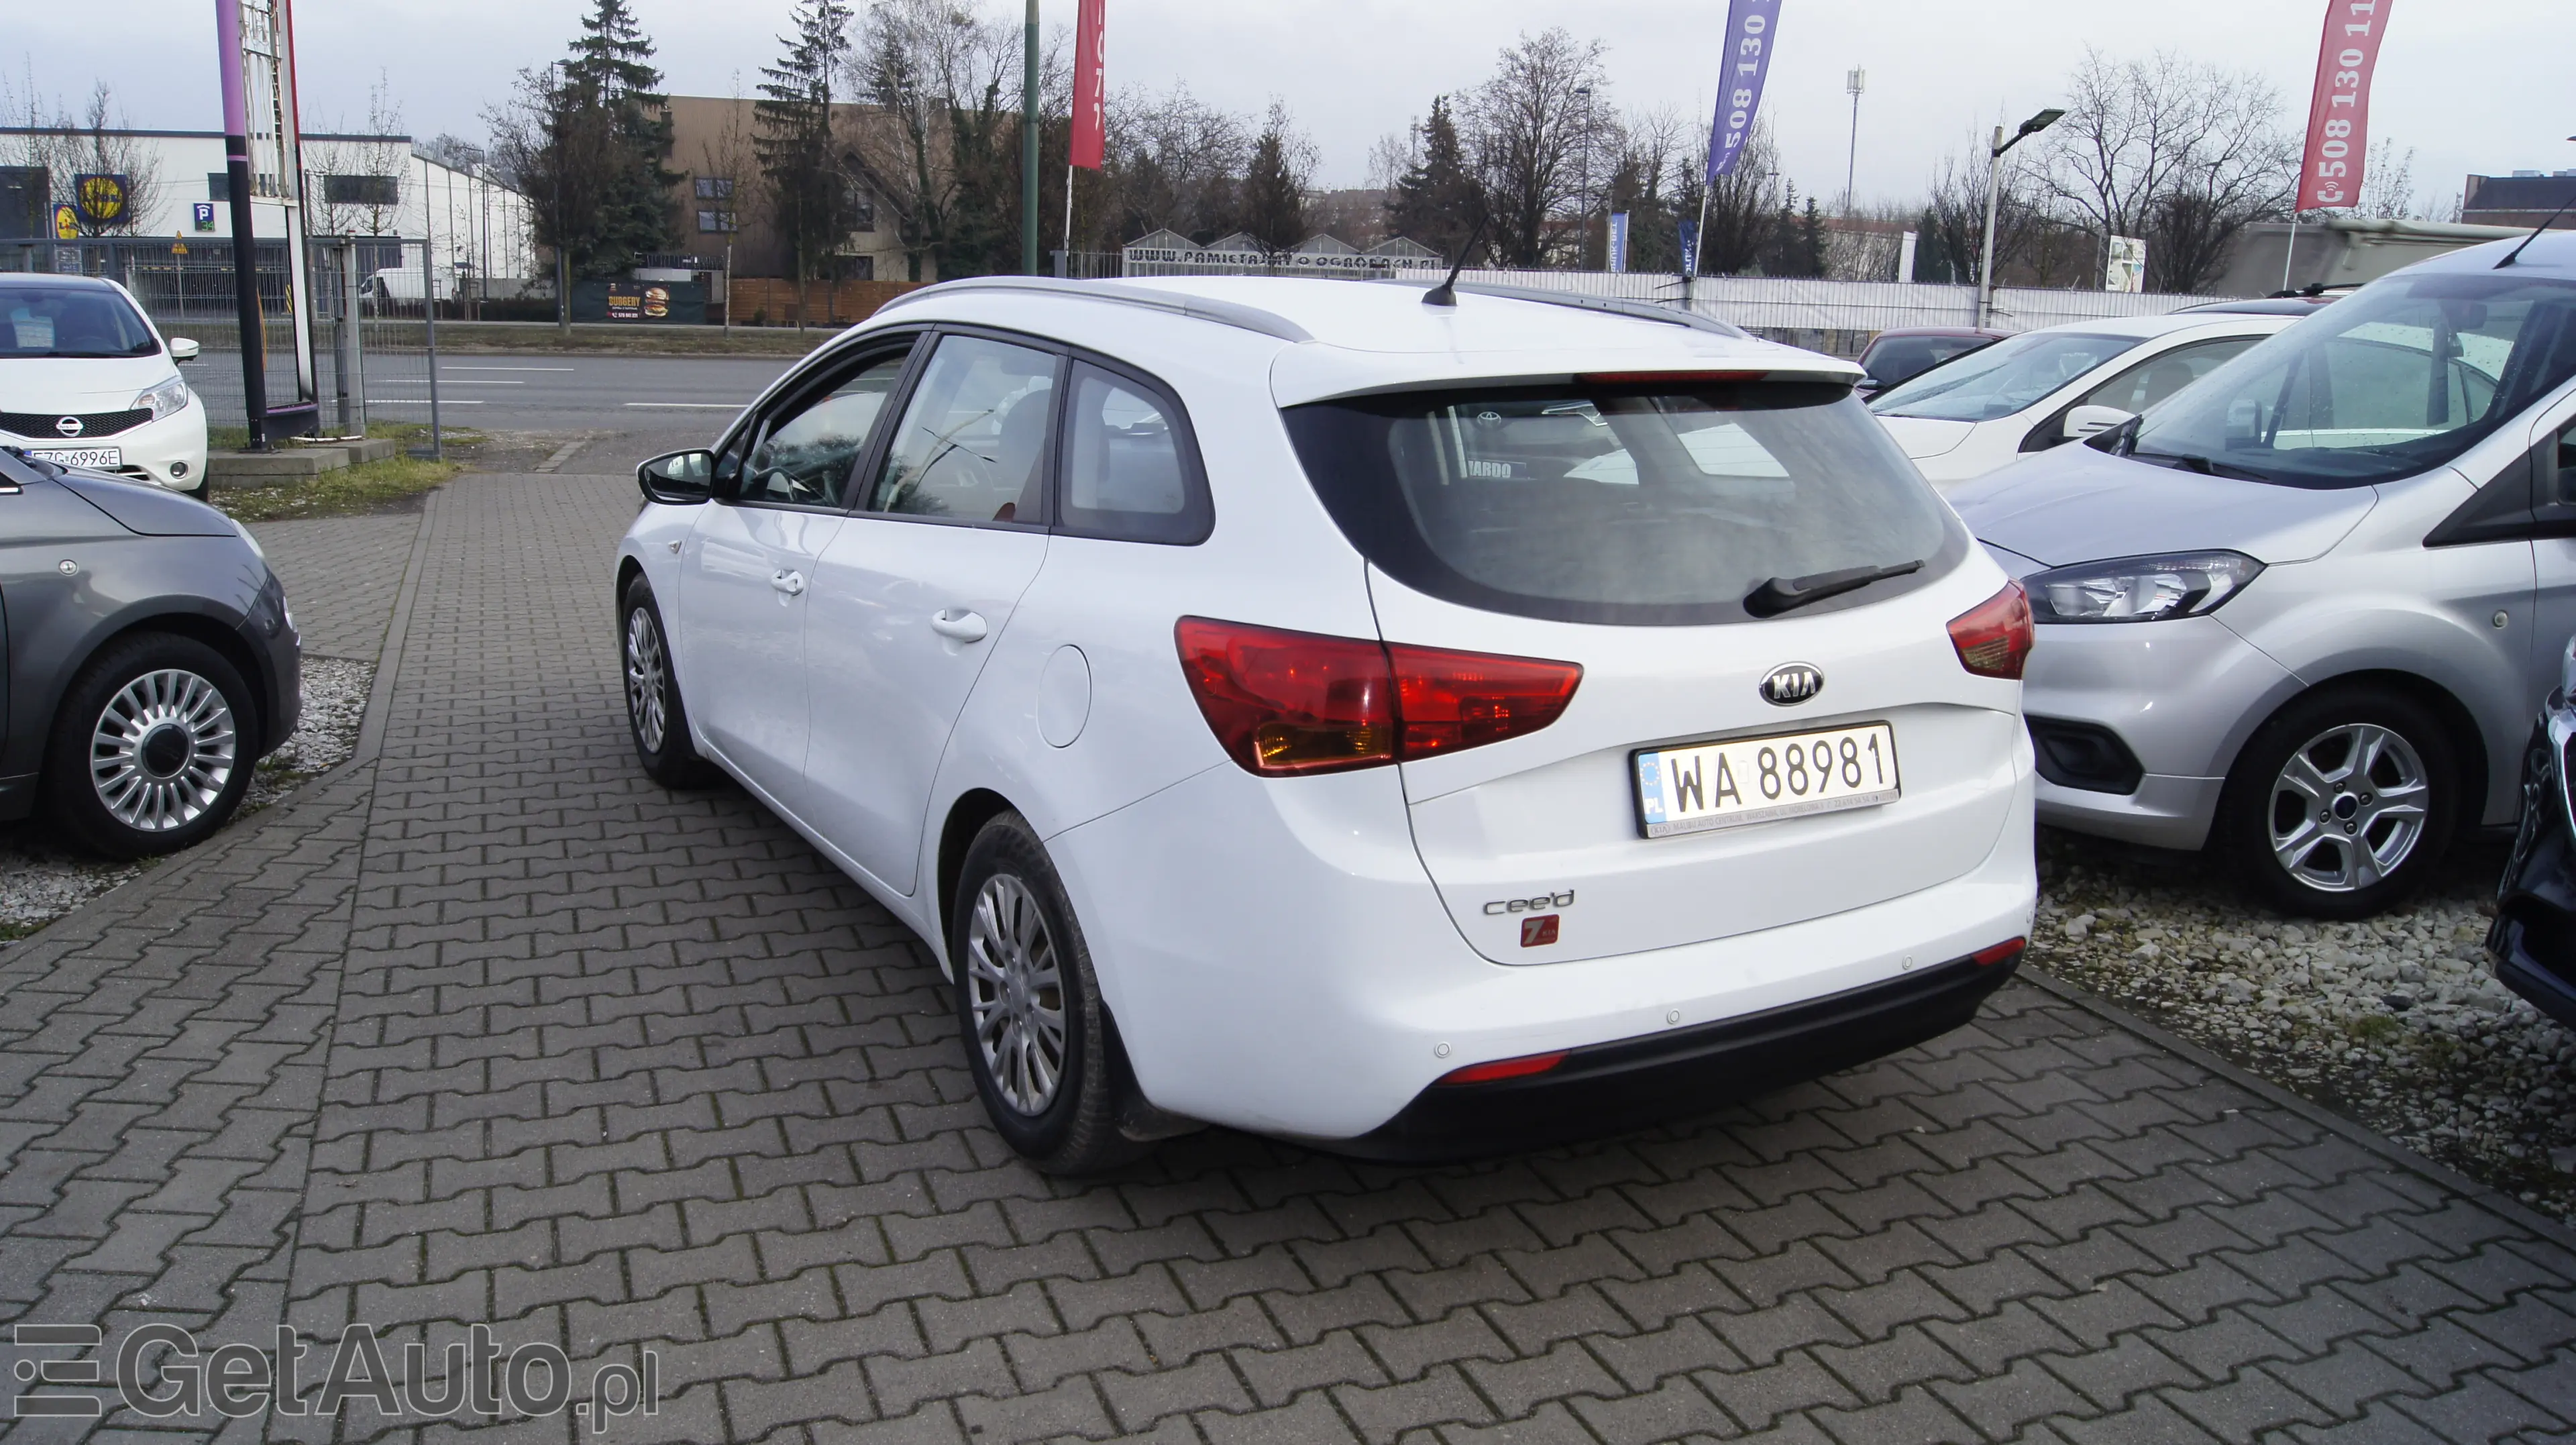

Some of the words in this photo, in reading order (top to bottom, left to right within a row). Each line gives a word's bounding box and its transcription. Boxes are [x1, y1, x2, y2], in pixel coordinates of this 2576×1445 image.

[1737, 15, 1766, 76] 130
[2331, 49, 2363, 107] 130
[1725, 89, 1752, 148] 508
[2318, 119, 2351, 177] 508
[70, 450, 118, 466] 6996E
[1772, 672, 1816, 699] KIA
[1671, 751, 1742, 812] WA
[1757, 733, 1884, 800] 88981
[1644, 797, 1664, 814] PL
